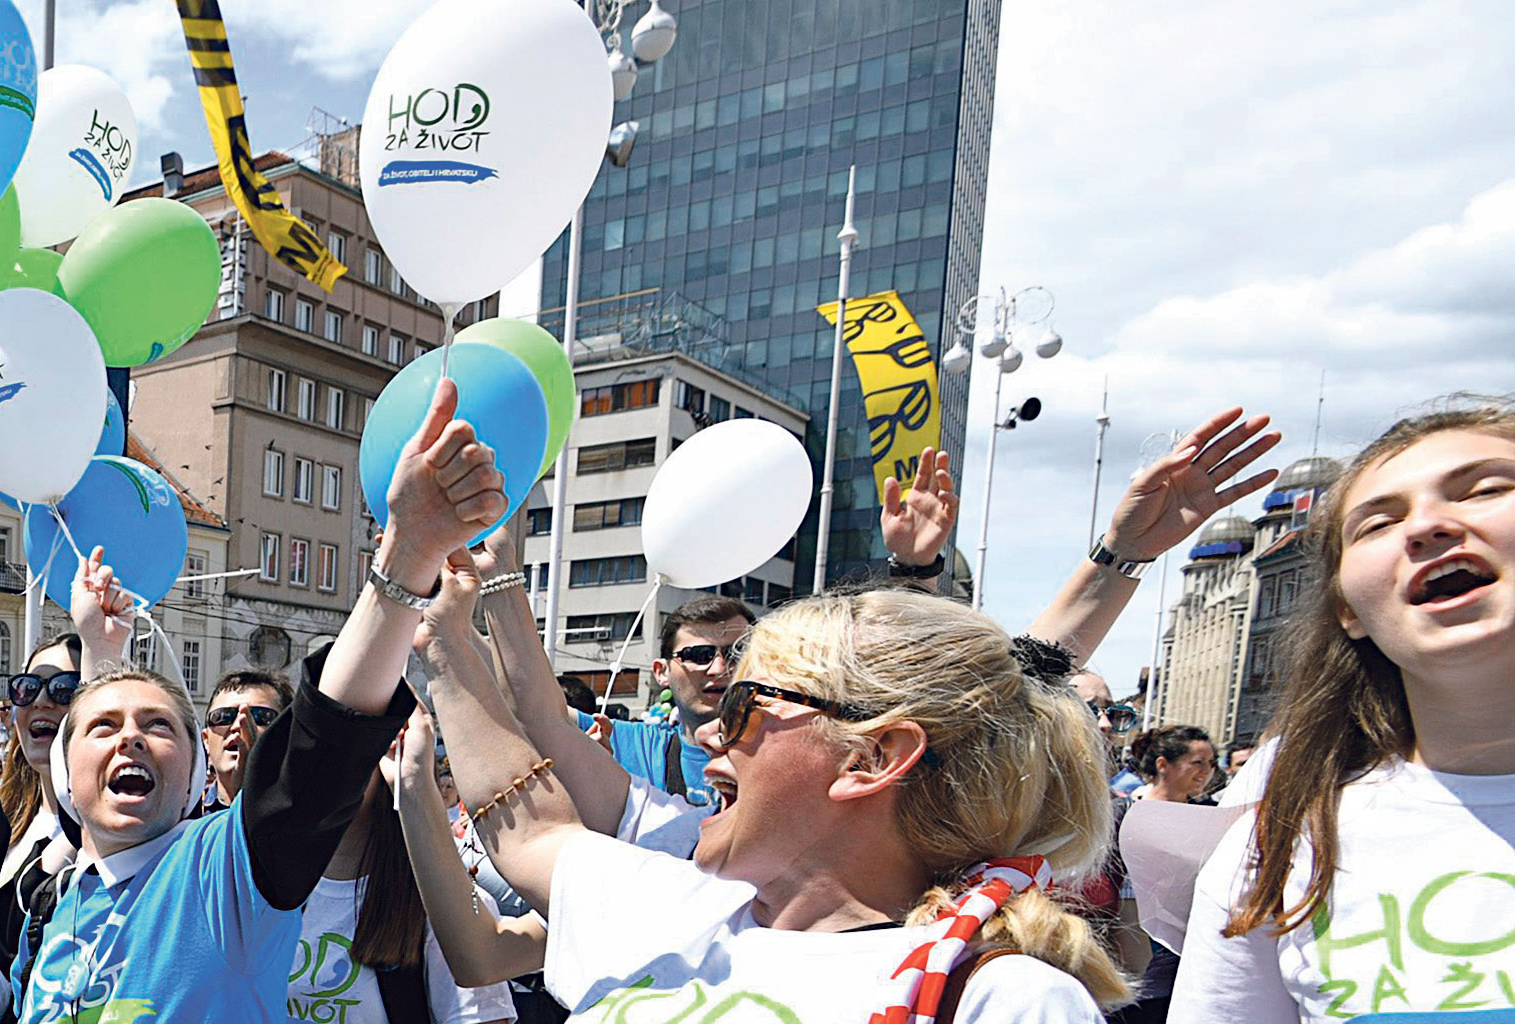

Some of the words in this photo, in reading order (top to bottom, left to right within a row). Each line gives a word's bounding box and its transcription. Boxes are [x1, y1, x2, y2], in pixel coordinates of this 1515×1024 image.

[390, 82, 491, 133] HOD
[90, 108, 132, 171] HOD
[384, 128, 410, 152] ZA
[414, 128, 491, 154] ŽIVOT
[1317, 963, 1411, 1019] ZA
